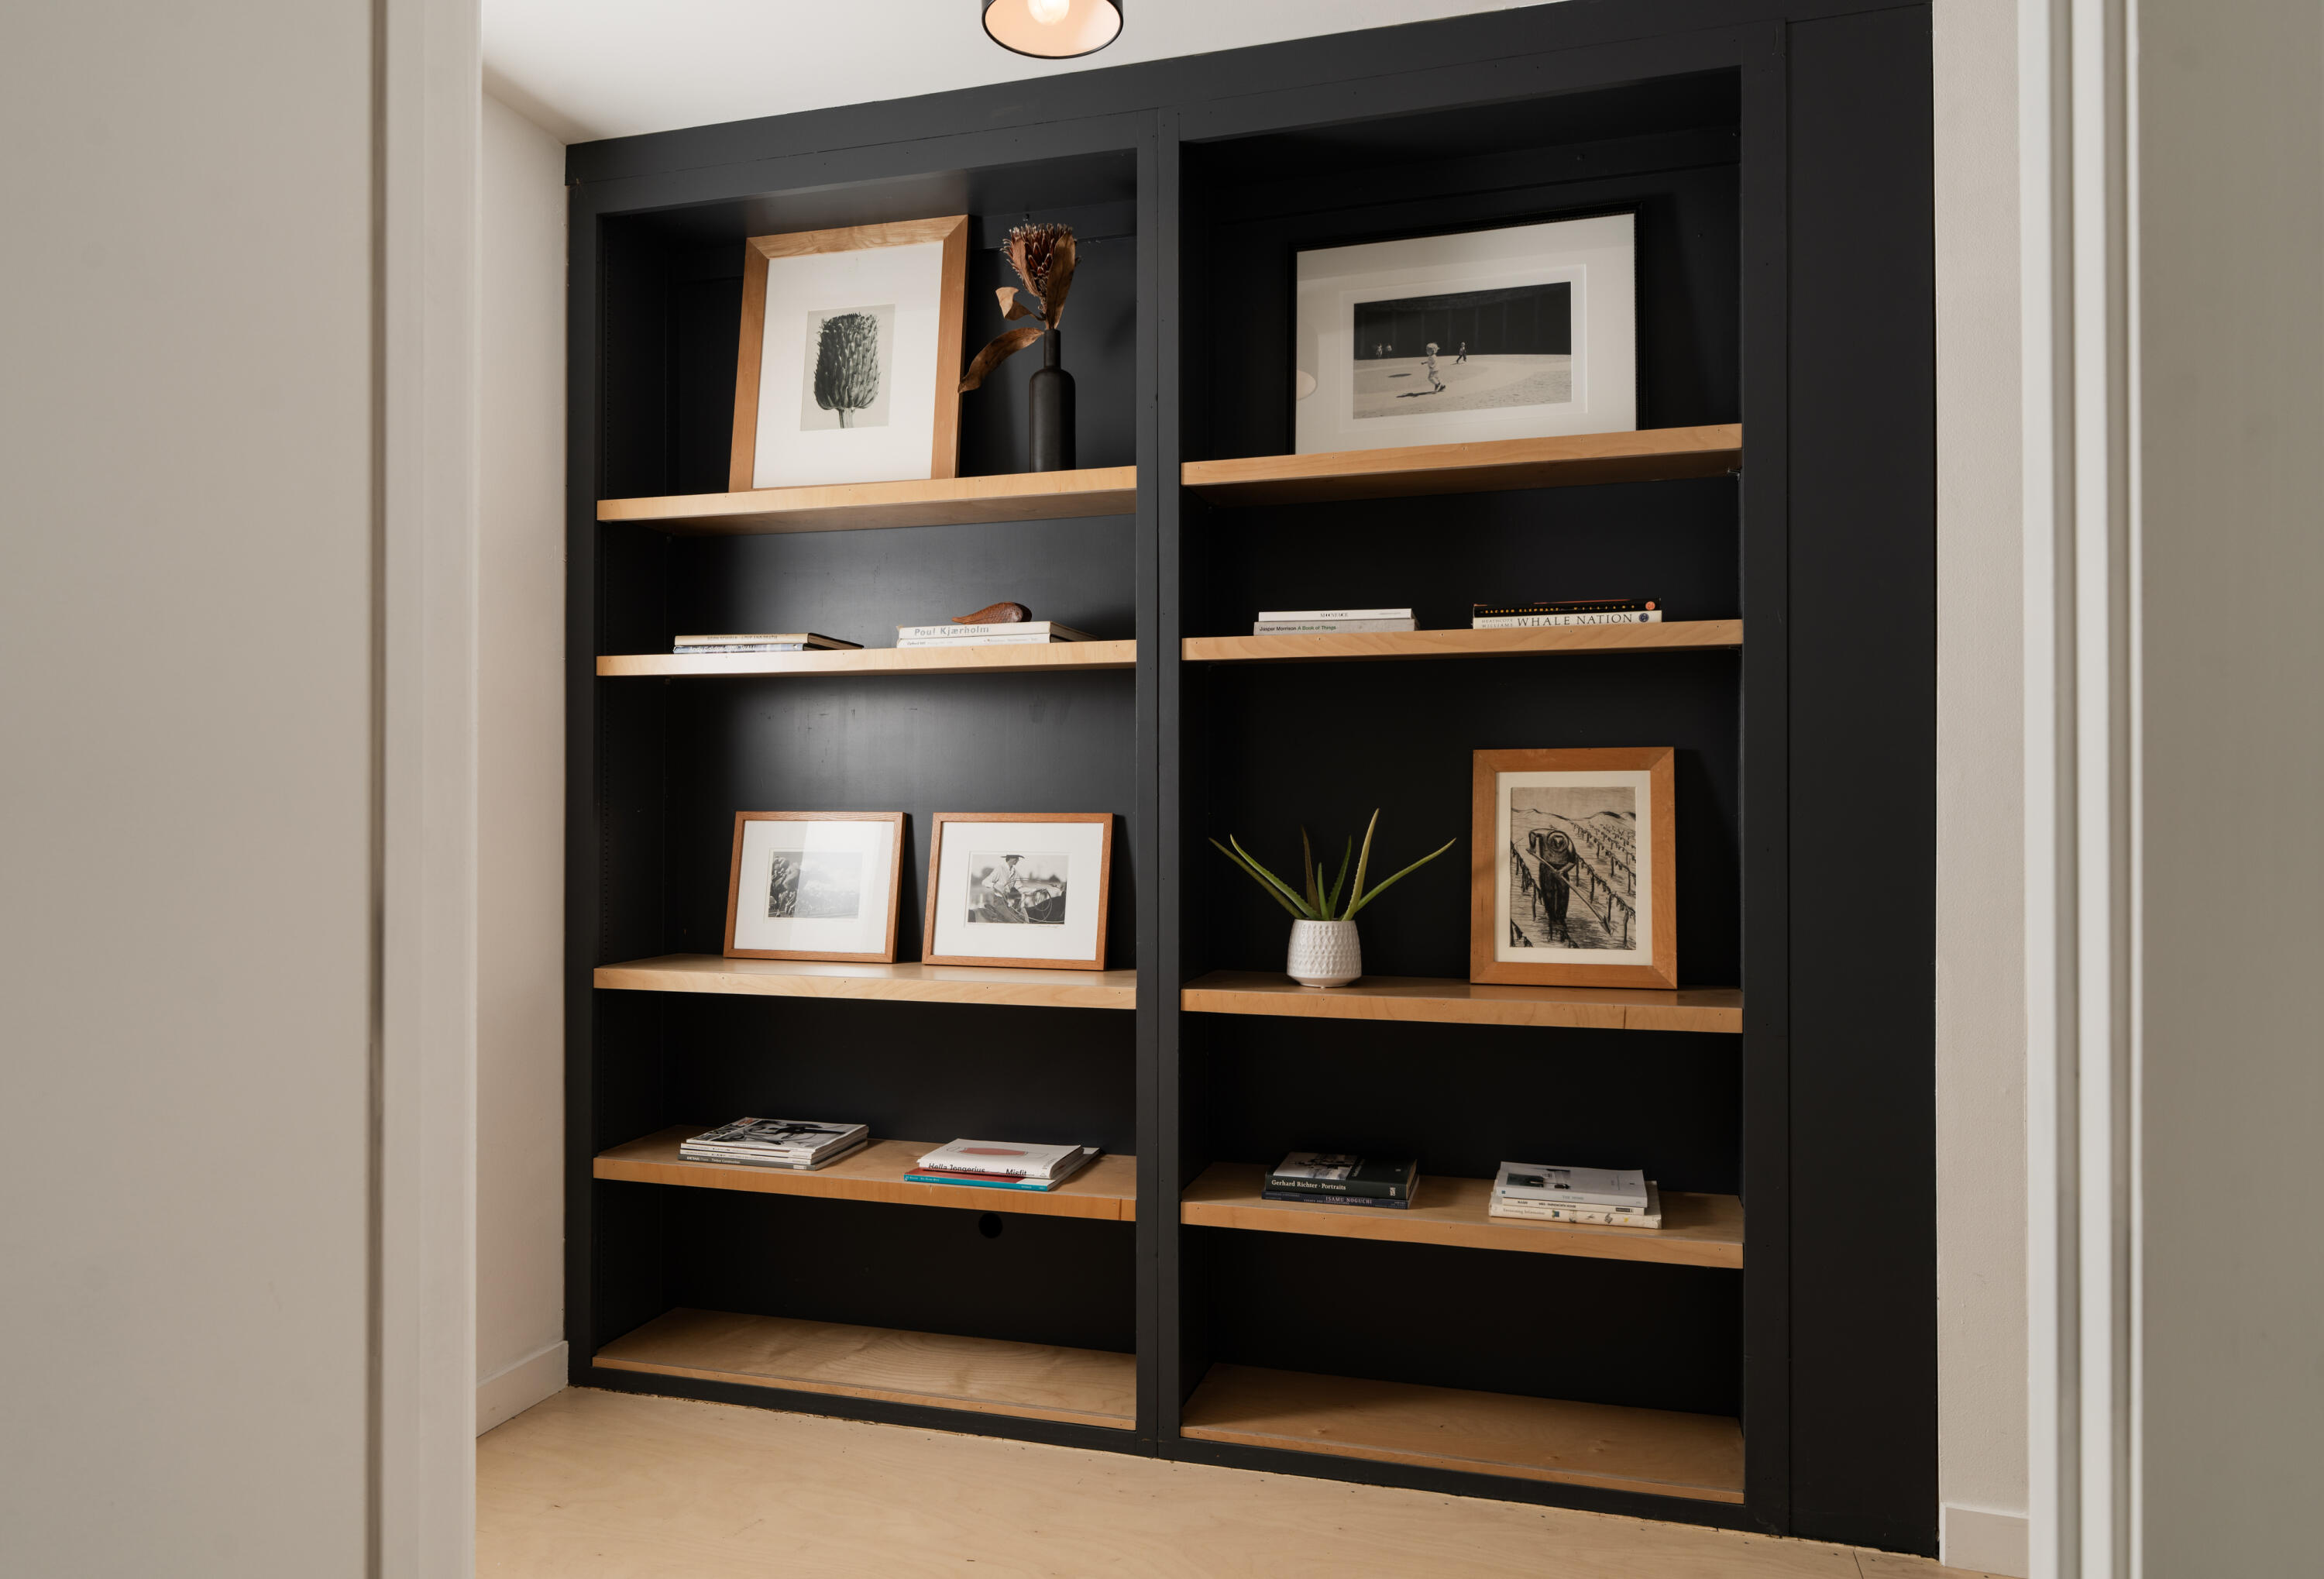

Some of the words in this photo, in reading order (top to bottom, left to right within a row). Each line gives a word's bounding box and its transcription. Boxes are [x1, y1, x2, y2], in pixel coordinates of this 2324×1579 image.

[1518, 616, 1570, 626] WHALE
[1576, 614, 1631, 624] NATION
[914, 628, 936, 636] Poul
[940, 625, 989, 636] Kjærholm
